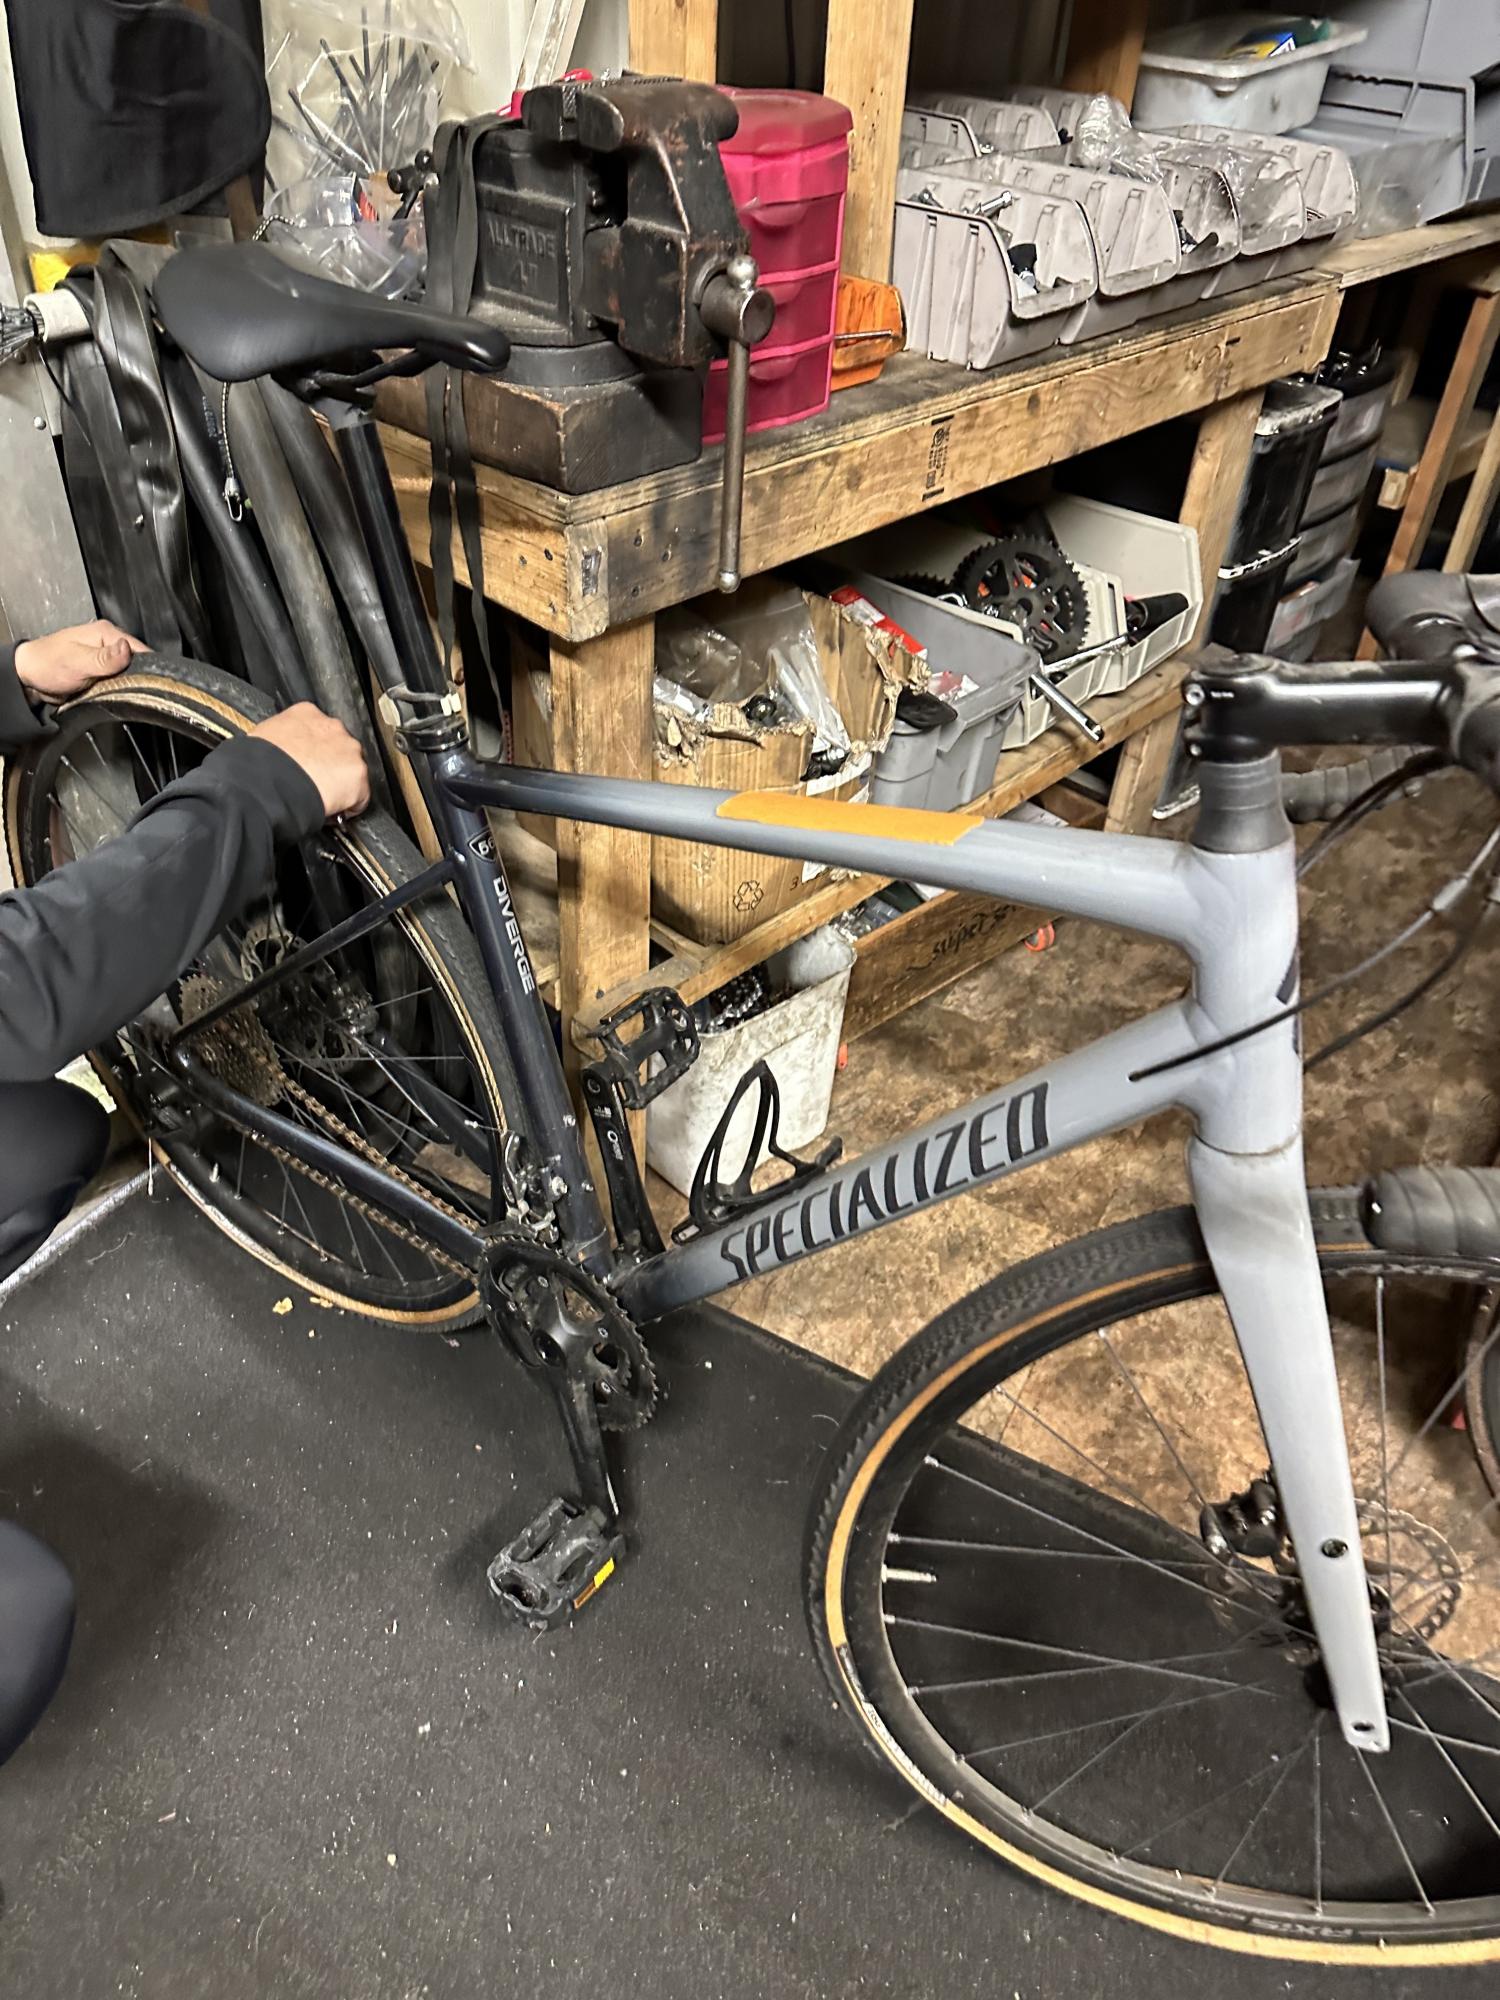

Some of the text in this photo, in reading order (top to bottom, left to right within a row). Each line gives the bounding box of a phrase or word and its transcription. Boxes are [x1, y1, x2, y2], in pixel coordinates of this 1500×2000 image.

[486, 217, 557, 258] ALLTRADE
[493, 875, 536, 995] DIVERGE
[720, 1081, 1050, 1286] SPECIALIZED
